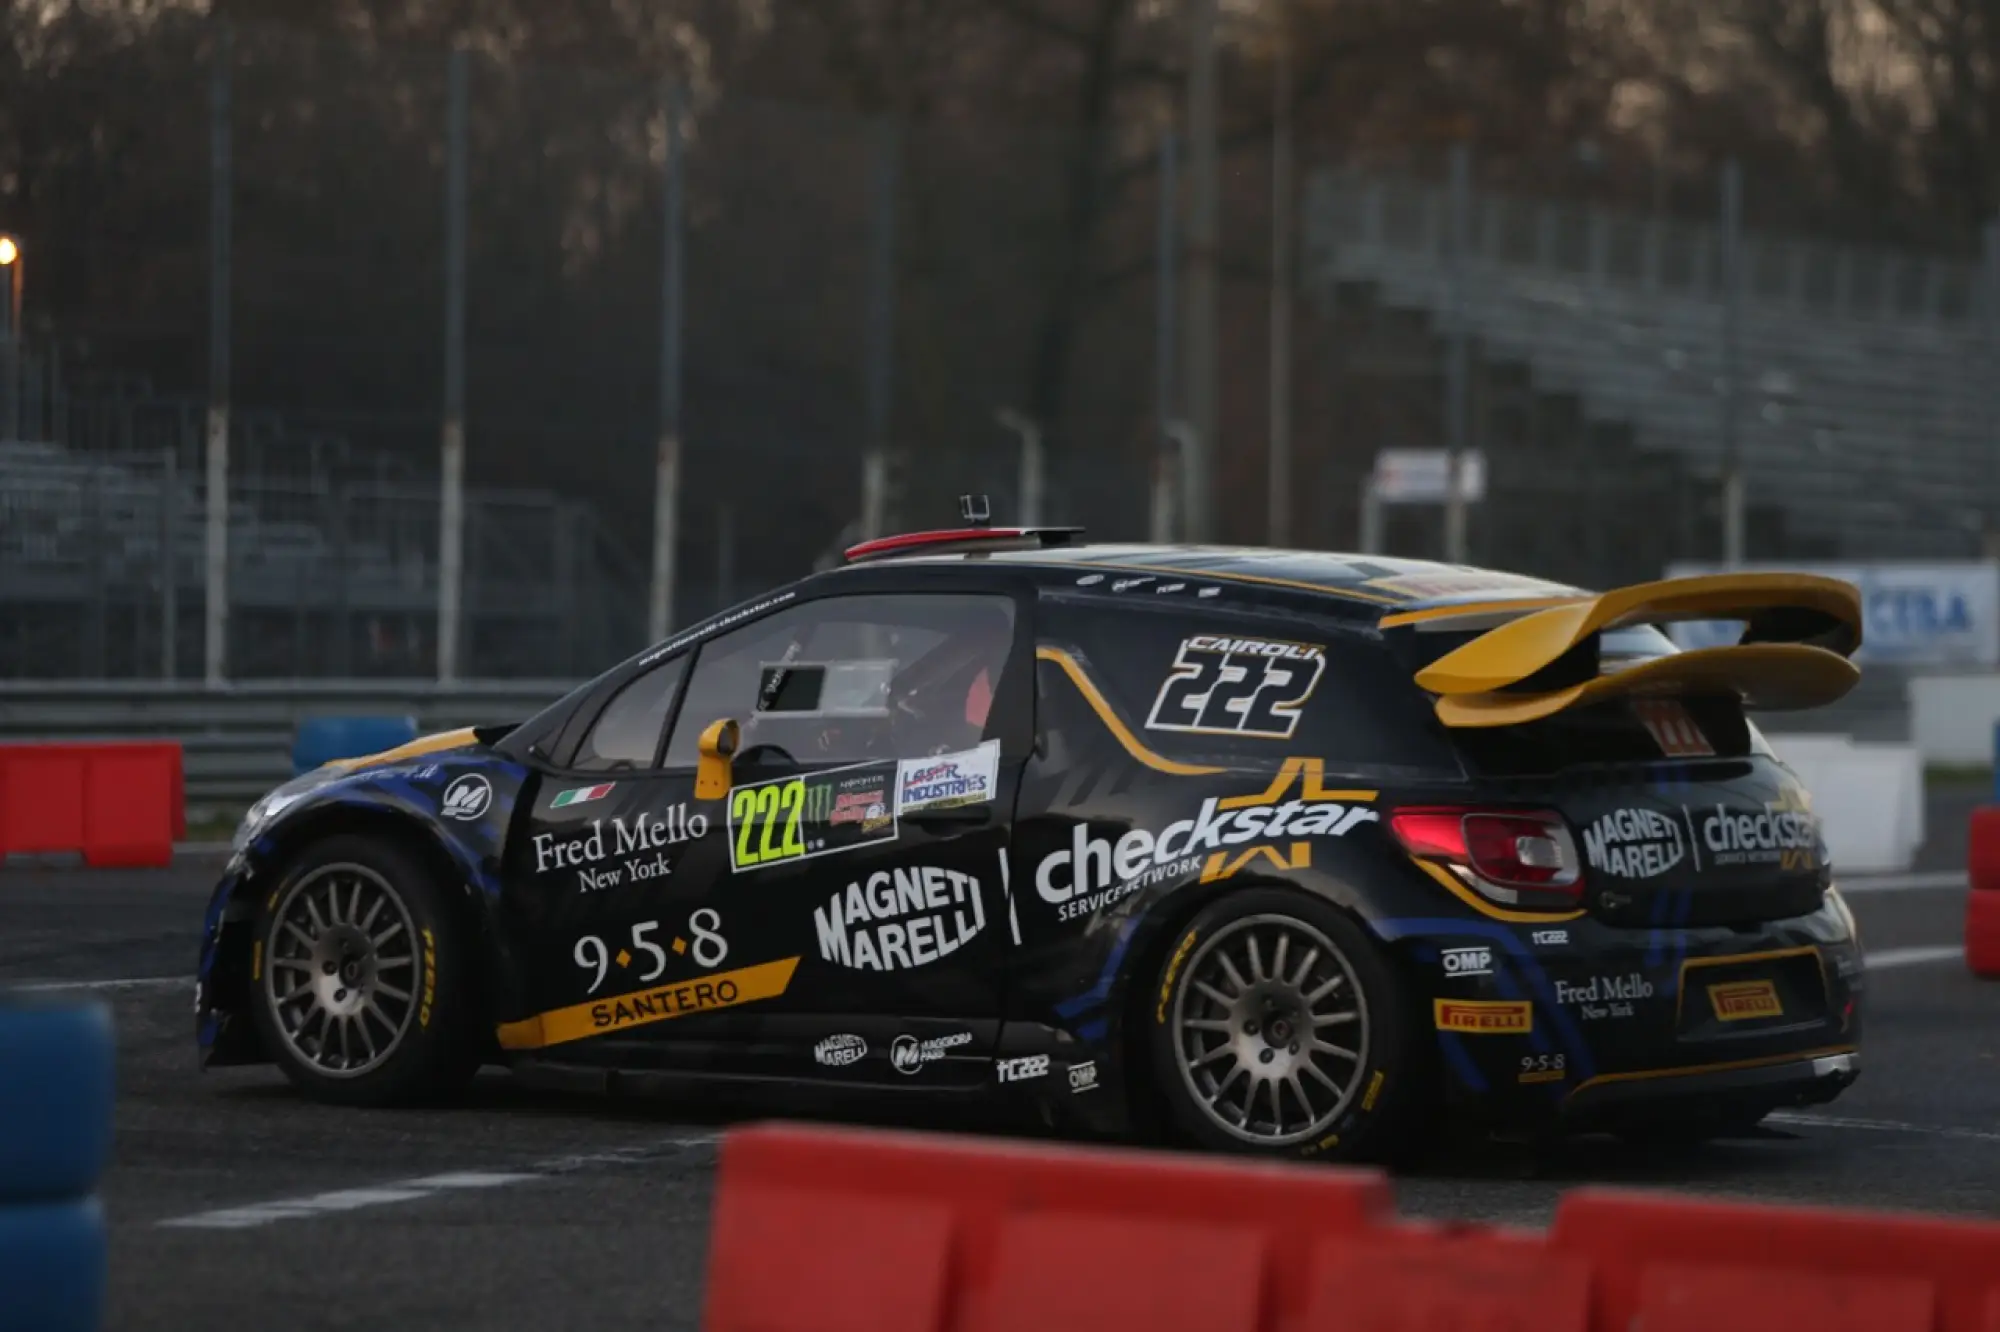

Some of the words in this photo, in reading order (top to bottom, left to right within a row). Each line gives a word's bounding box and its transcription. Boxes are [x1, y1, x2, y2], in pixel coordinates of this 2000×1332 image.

[1188, 636, 1322, 660] CAIROLI
[1144, 640, 1326, 739] 222
[533, 819, 606, 872] Fred
[613, 802, 708, 856] Mello
[733, 780, 806, 867] 222
[1583, 808, 1684, 858] MAGNETI
[578, 868, 622, 893] New
[624, 852, 671, 882] York
[1036, 797, 1380, 903] checkstar
[1583, 826, 1684, 878] MARELLI
[814, 866, 986, 942] MAGNETI
[1058, 885, 1122, 922] SERVICE
[1122, 855, 1202, 894] NETWORK
[814, 892, 986, 971] MARELLI
[1442, 951, 1492, 973] OMP
[591, 980, 738, 1028] SANTERO
[1554, 976, 1599, 1004] Fred
[1603, 973, 1654, 1000] Mello
[1582, 1003, 1608, 1020] New
[1611, 1001, 1635, 1017] York
[1442, 1004, 1526, 1028] PIRELLI
[815, 1043, 867, 1066] MARELLI
[1068, 1064, 1097, 1089] OMP
